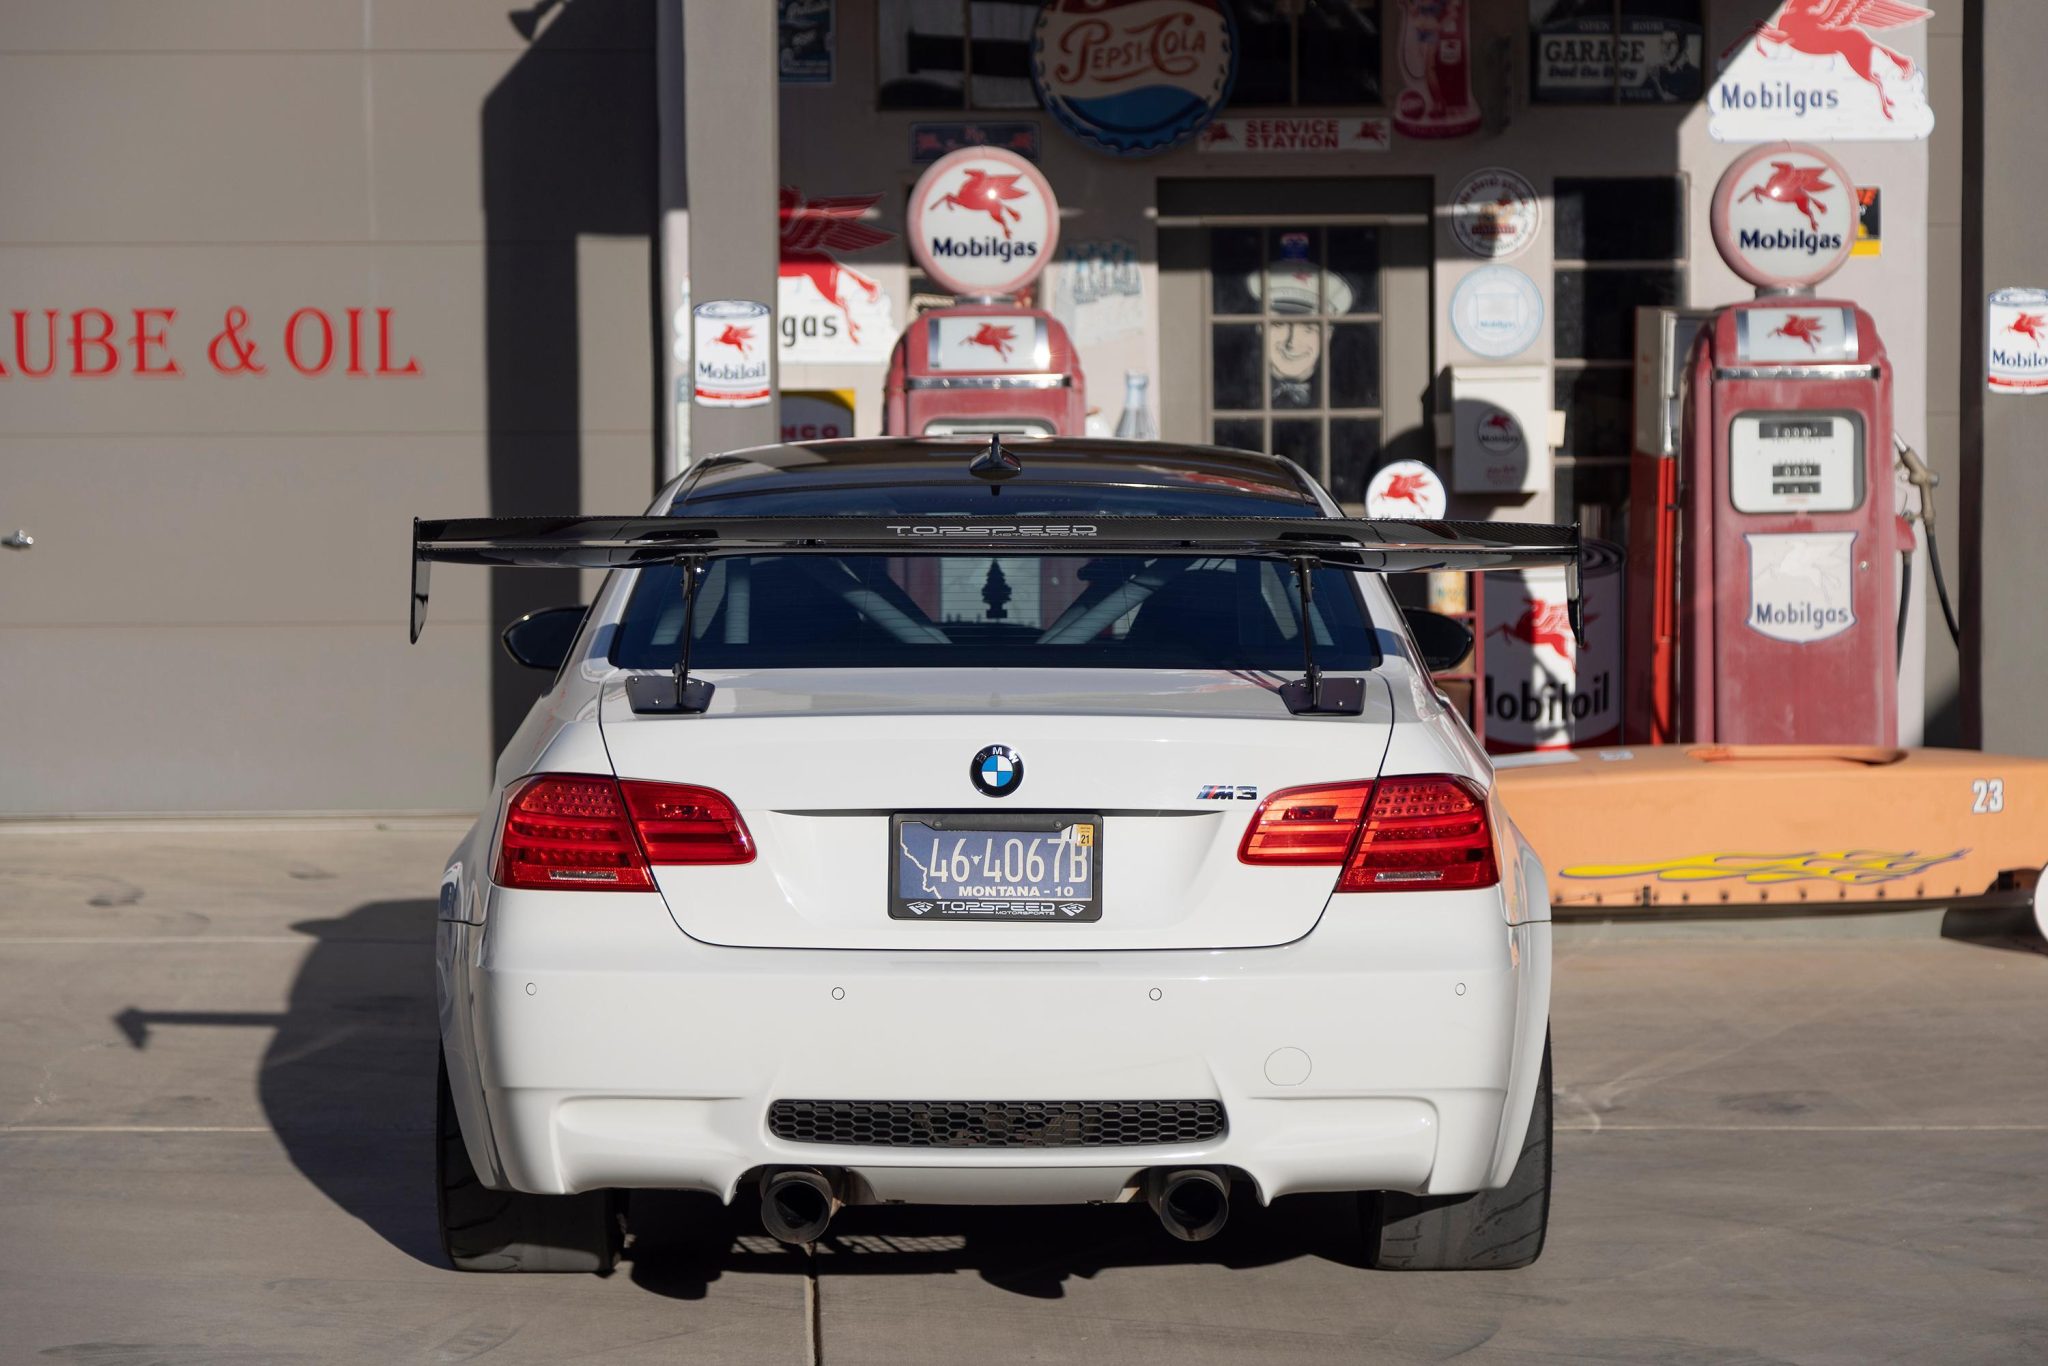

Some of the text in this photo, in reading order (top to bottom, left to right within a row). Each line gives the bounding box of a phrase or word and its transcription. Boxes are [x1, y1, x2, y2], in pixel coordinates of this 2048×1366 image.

[1545, 39, 1645, 63] GARAGE
[1720, 82, 1839, 117] Mobilgas
[1246, 119, 1340, 134] SERVICE
[1246, 134, 1340, 149] STATION
[931, 236, 1038, 263] Mobilgas
[1739, 227, 1842, 256] Mobilgas
[0, 305, 424, 378] UBE & OIL
[698, 360, 767, 383] Mobiloil
[887, 525, 1098, 534] TOPSPEED
[1756, 602, 1849, 631] Mobilgas
[976, 746, 1019, 765] BMW
[1972, 777, 2005, 815] 23
[1080, 834, 1090, 845] 21
[958, 885, 1041, 897] MONTANA
[1054, 885, 1075, 897] 10
[936, 900, 1056, 911] TOPSPEED
